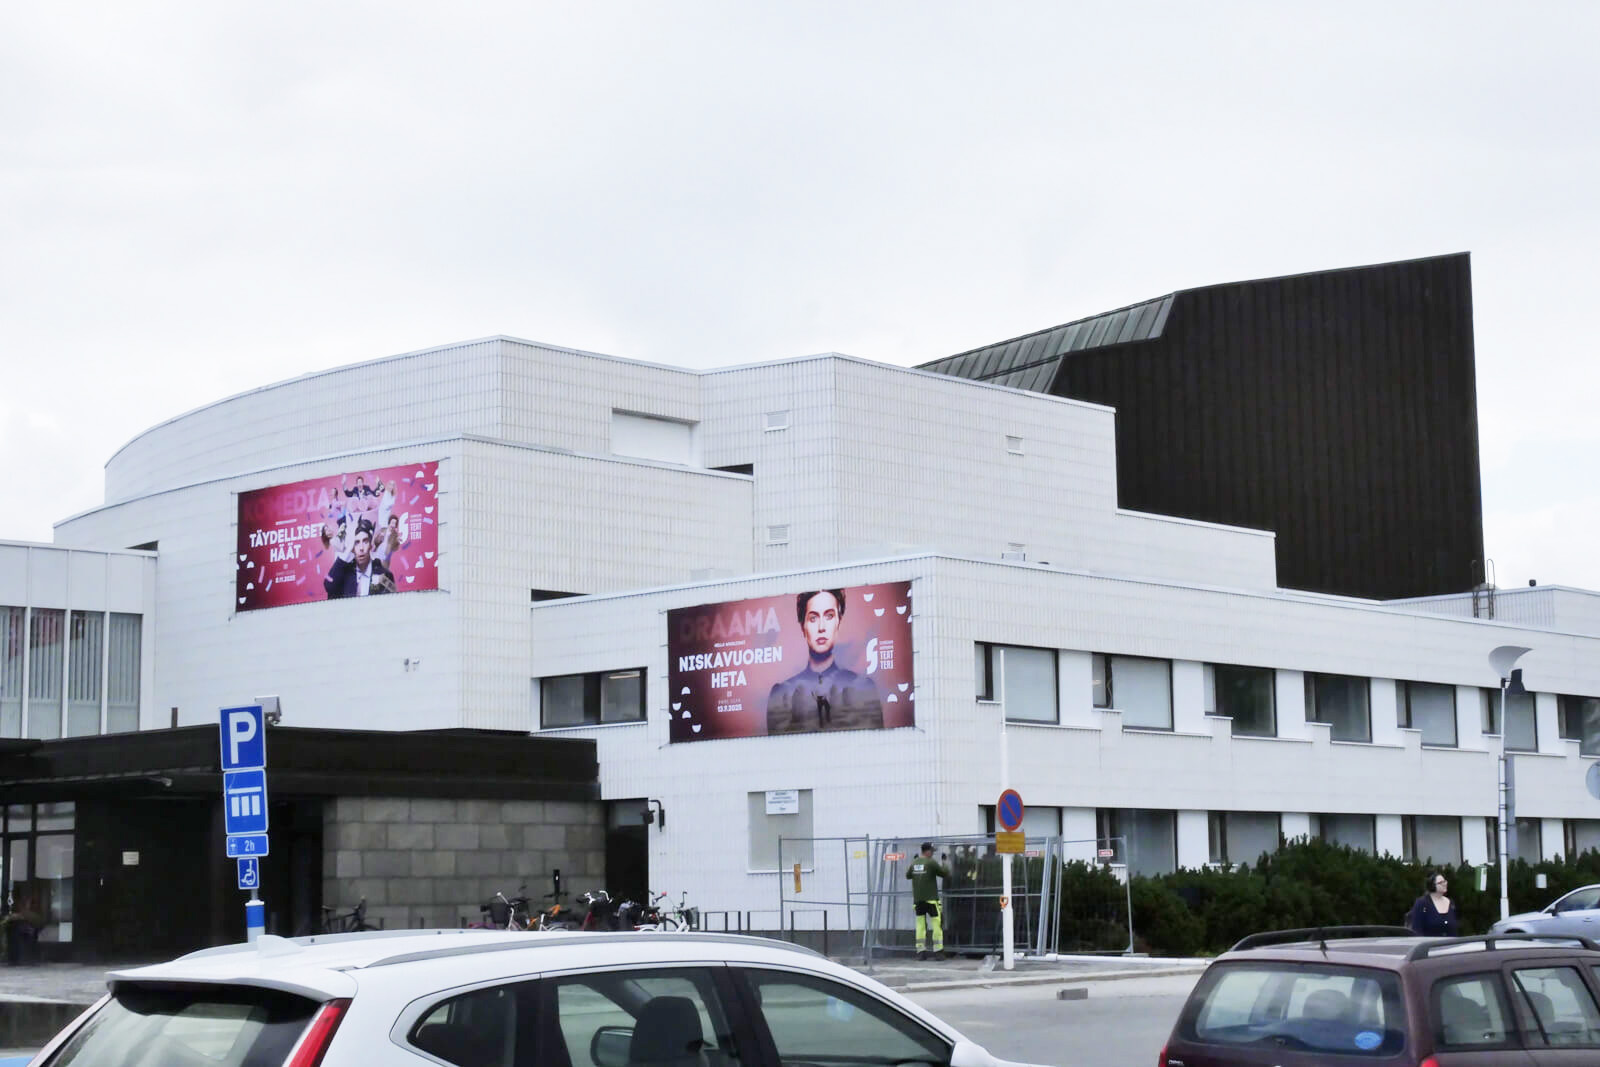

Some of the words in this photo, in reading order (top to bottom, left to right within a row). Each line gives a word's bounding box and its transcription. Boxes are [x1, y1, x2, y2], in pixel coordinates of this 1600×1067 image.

[249, 522, 325, 548] TÄYDELLISET
[270, 544, 302, 563] HÄÄT
[680, 607, 780, 639] DRAAMA
[679, 647, 782, 672] NISKAVUOREN
[711, 671, 747, 689] HETA
[228, 711, 257, 765] P
[244, 840, 255, 852] 2h
